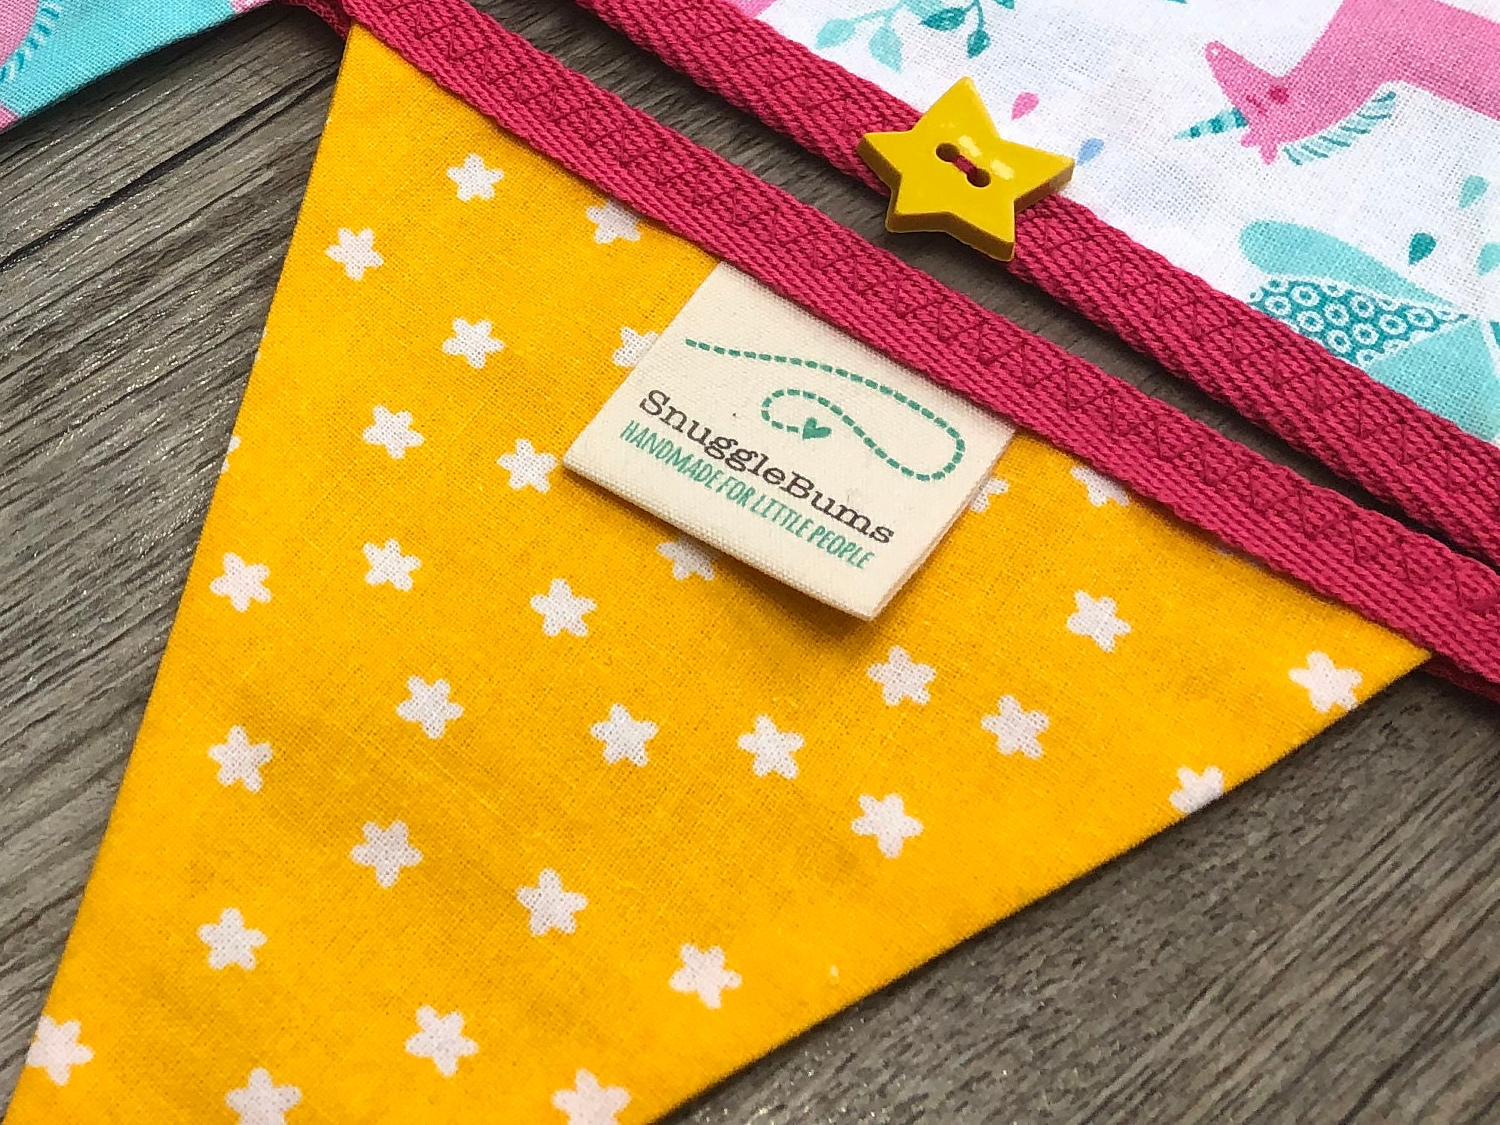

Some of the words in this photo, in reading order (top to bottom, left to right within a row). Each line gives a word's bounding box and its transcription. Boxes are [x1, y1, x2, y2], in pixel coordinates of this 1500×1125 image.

[620, 420, 725, 489] HANDMADE
[715, 475, 757, 508] FOR
[749, 494, 814, 538] LITTLE
[807, 525, 875, 570] PEOPLE
[639, 389, 895, 544] SnuggleBums
